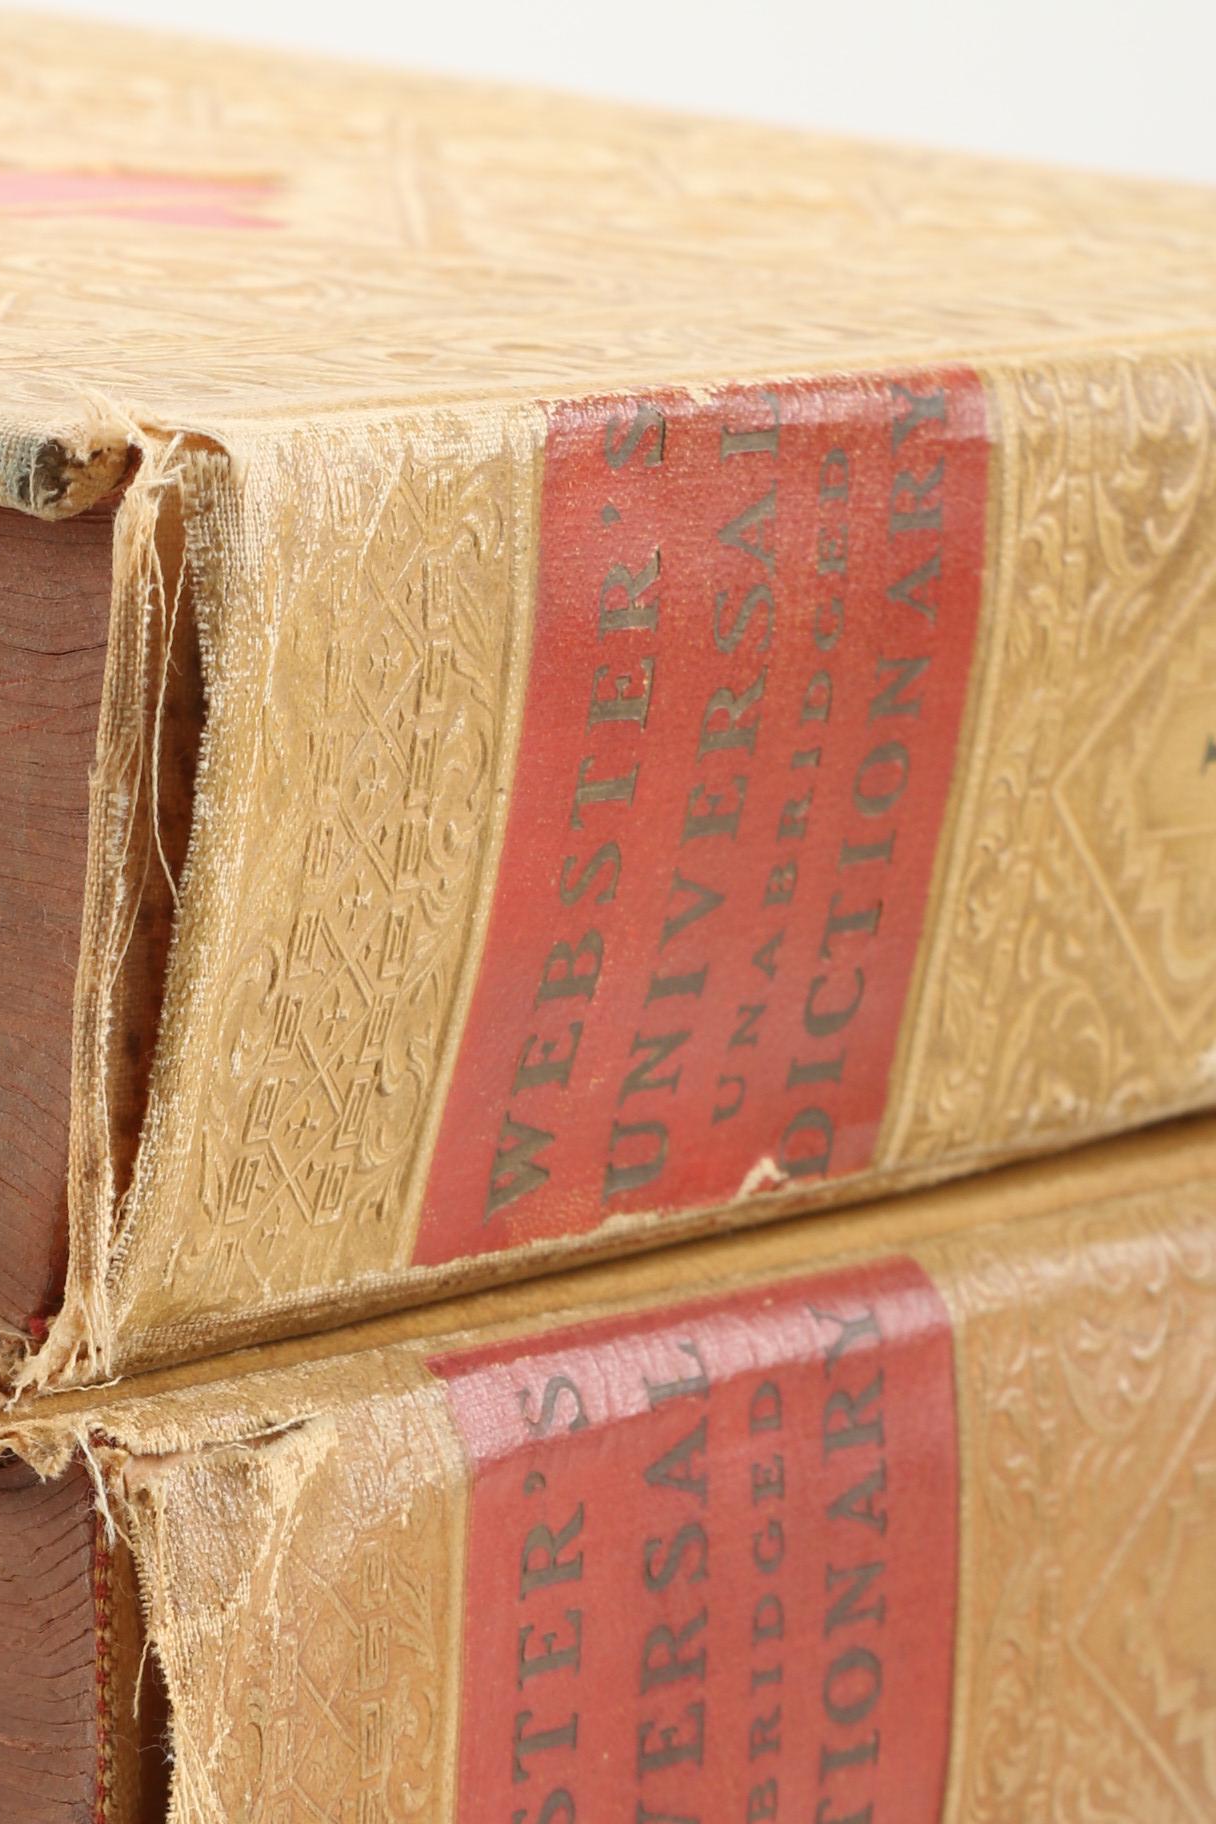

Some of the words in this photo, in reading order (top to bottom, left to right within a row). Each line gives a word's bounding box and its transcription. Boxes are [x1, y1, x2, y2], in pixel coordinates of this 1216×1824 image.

[484, 405, 666, 1226] WEBSTER'S
[602, 392, 780, 1204] UNIVERSAL
[711, 447, 851, 1125] UNABRIDGED
[780, 383, 947, 1180] DICTIONARY
